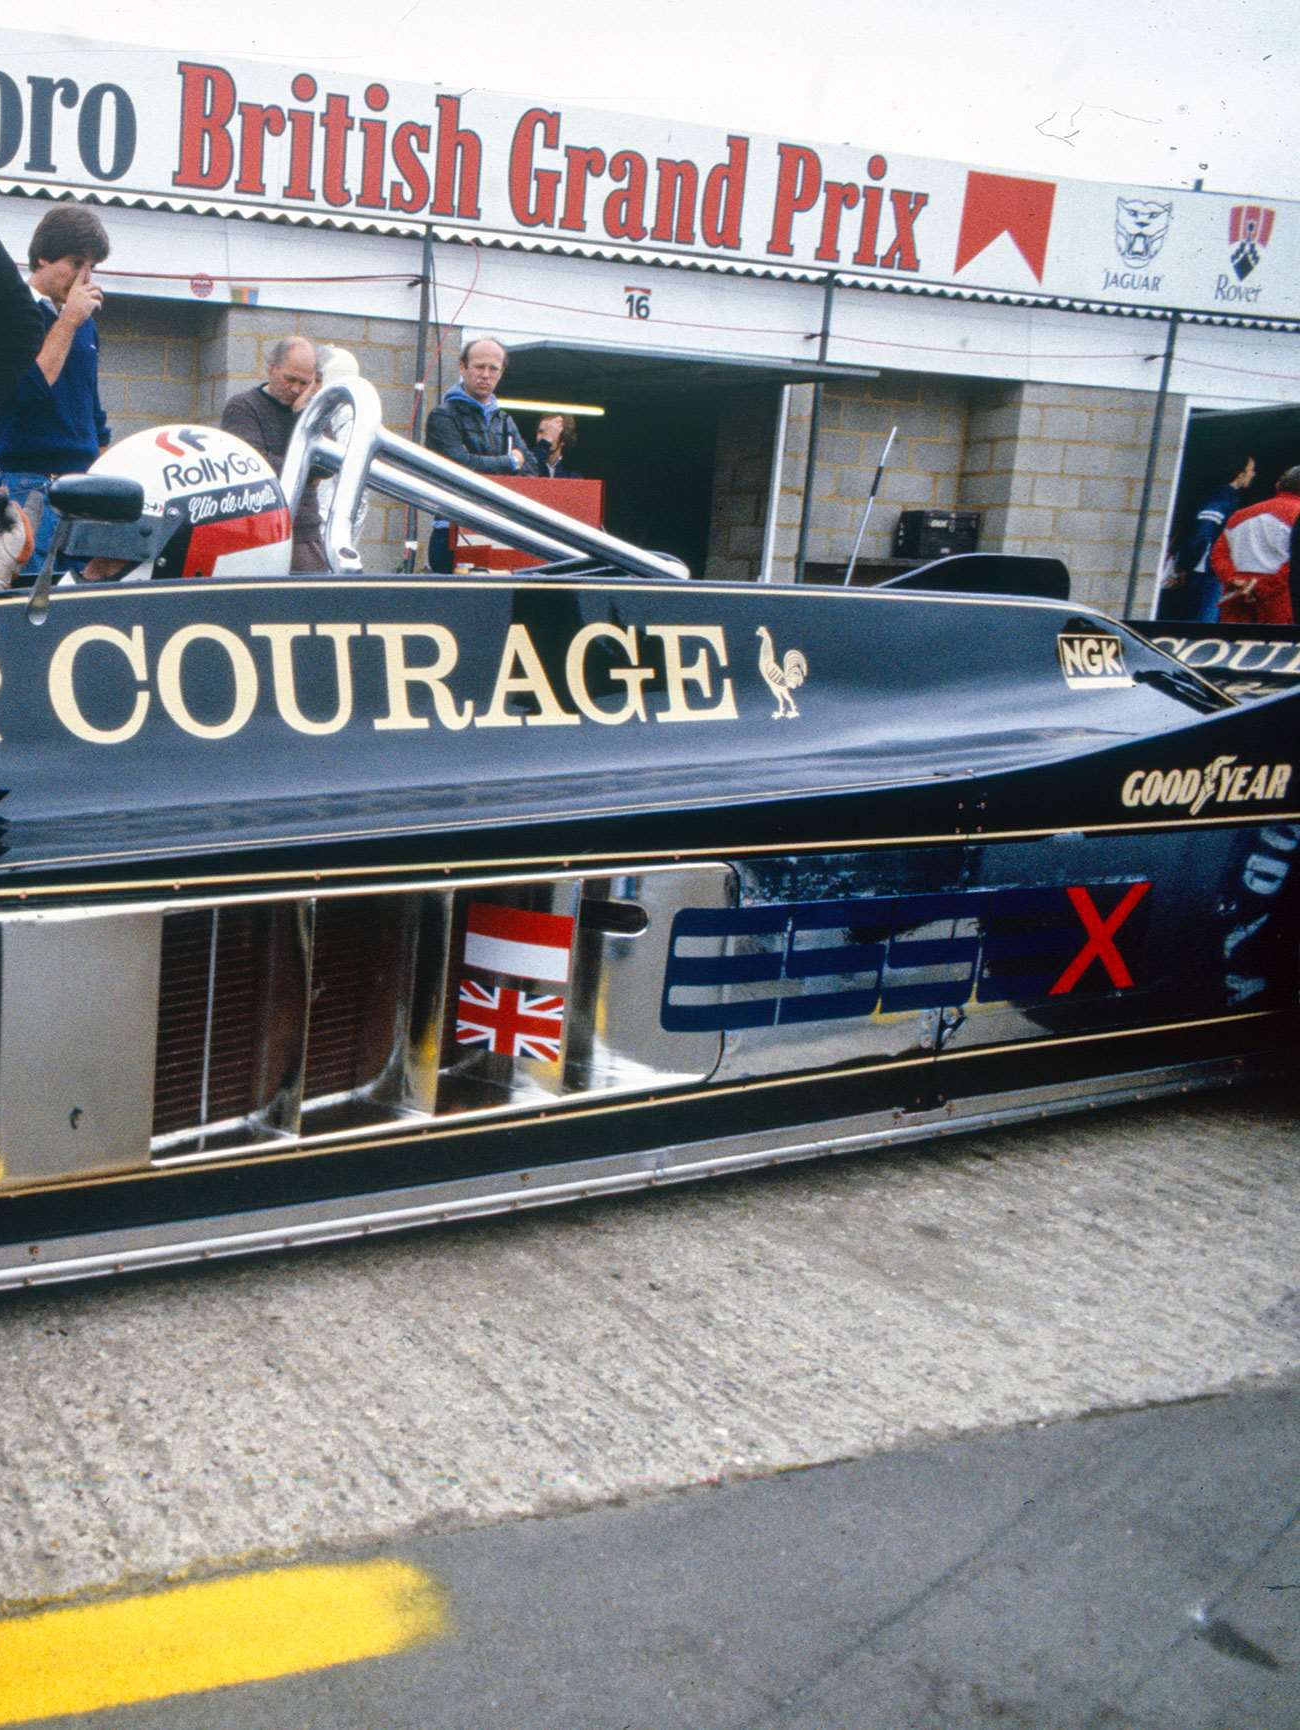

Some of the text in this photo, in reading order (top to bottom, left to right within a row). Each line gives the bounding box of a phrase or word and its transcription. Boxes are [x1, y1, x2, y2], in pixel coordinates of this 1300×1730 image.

[172, 61, 930, 272] British Grand Prix
[1102, 270, 1163, 292] JAGUAR
[1214, 273, 1263, 303] Rover
[625, 293, 651, 320] 16
[162, 452, 261, 492] RollyGo
[188, 495, 219, 524] Elio
[220, 491, 237, 514] de
[1062, 636, 1124, 677] NGK
[46, 621, 740, 745] COURAGE
